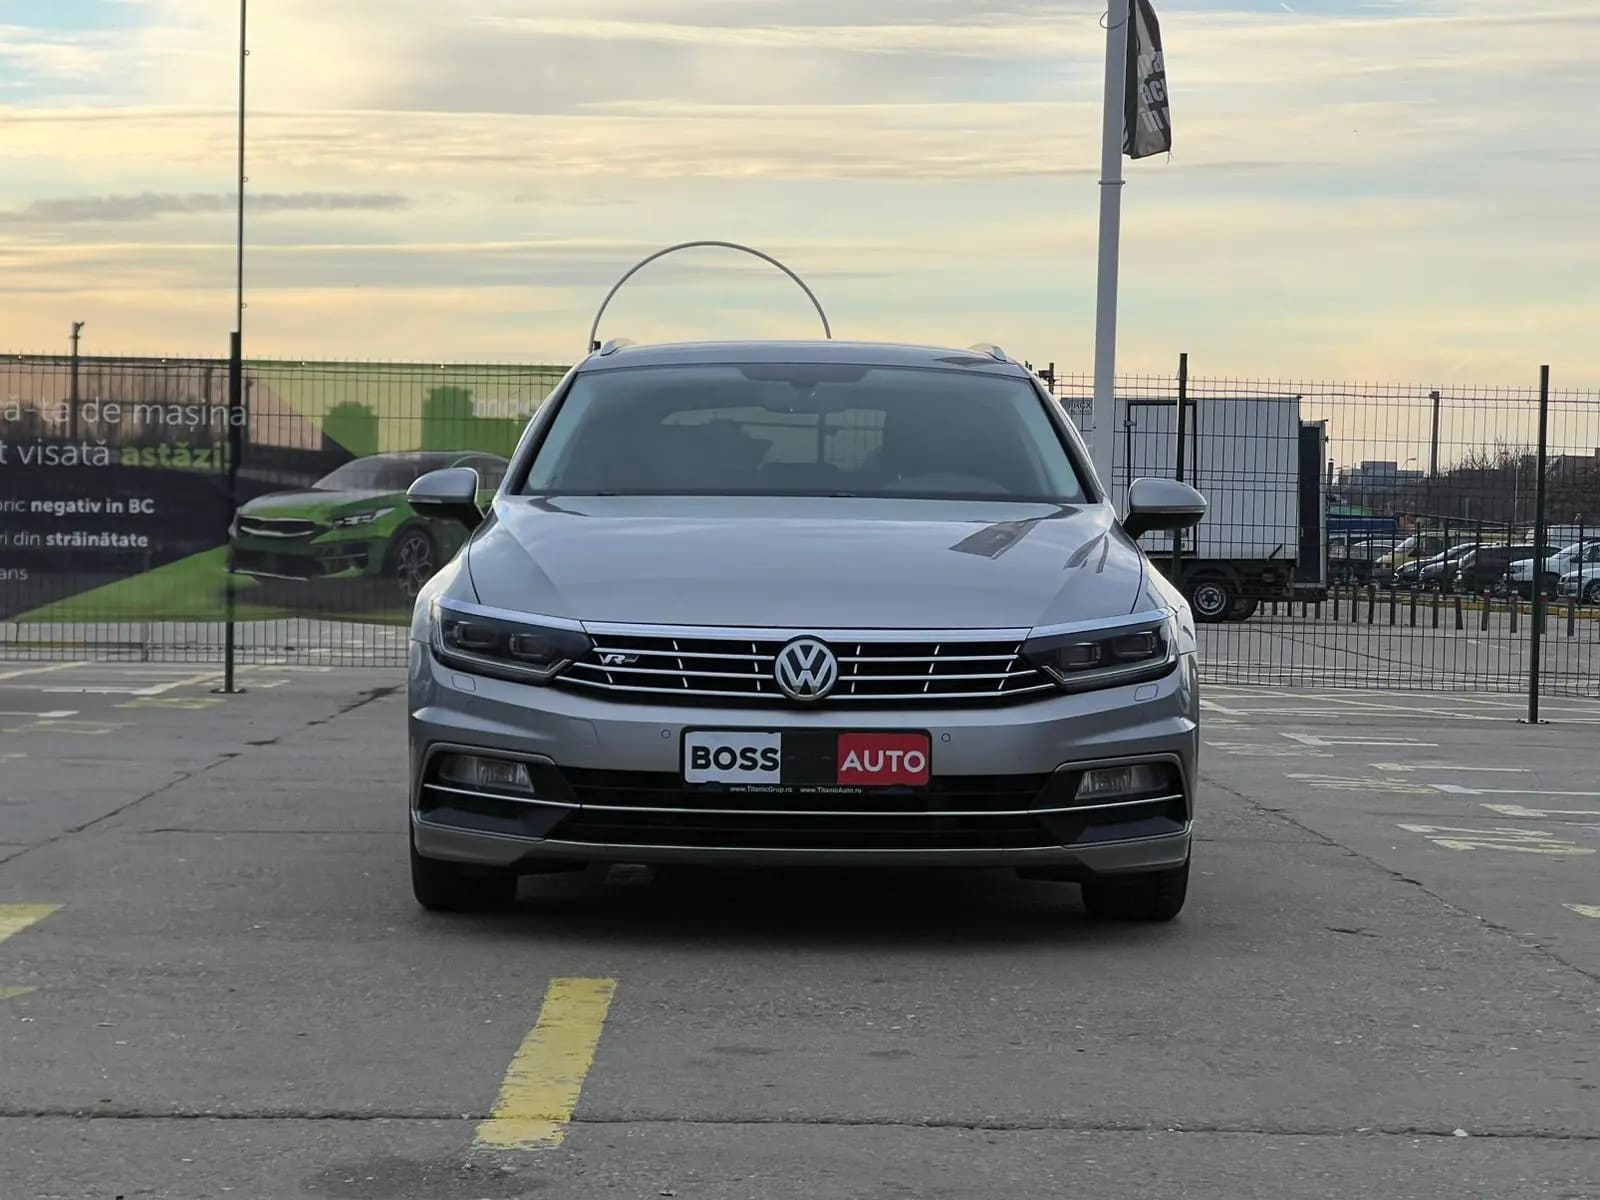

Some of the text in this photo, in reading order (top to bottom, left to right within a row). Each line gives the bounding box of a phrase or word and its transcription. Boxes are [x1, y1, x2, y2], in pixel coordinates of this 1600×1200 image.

[82, 396, 120, 424] de
[132, 398, 246, 433] mașina
[17, 438, 110, 466] visată
[31, 498, 101, 516] negativ
[129, 499, 155, 514] BC
[13, 530, 41, 547] din
[46, 531, 149, 548] străinătate
[691, 746, 926, 773] BOSS AUTO
